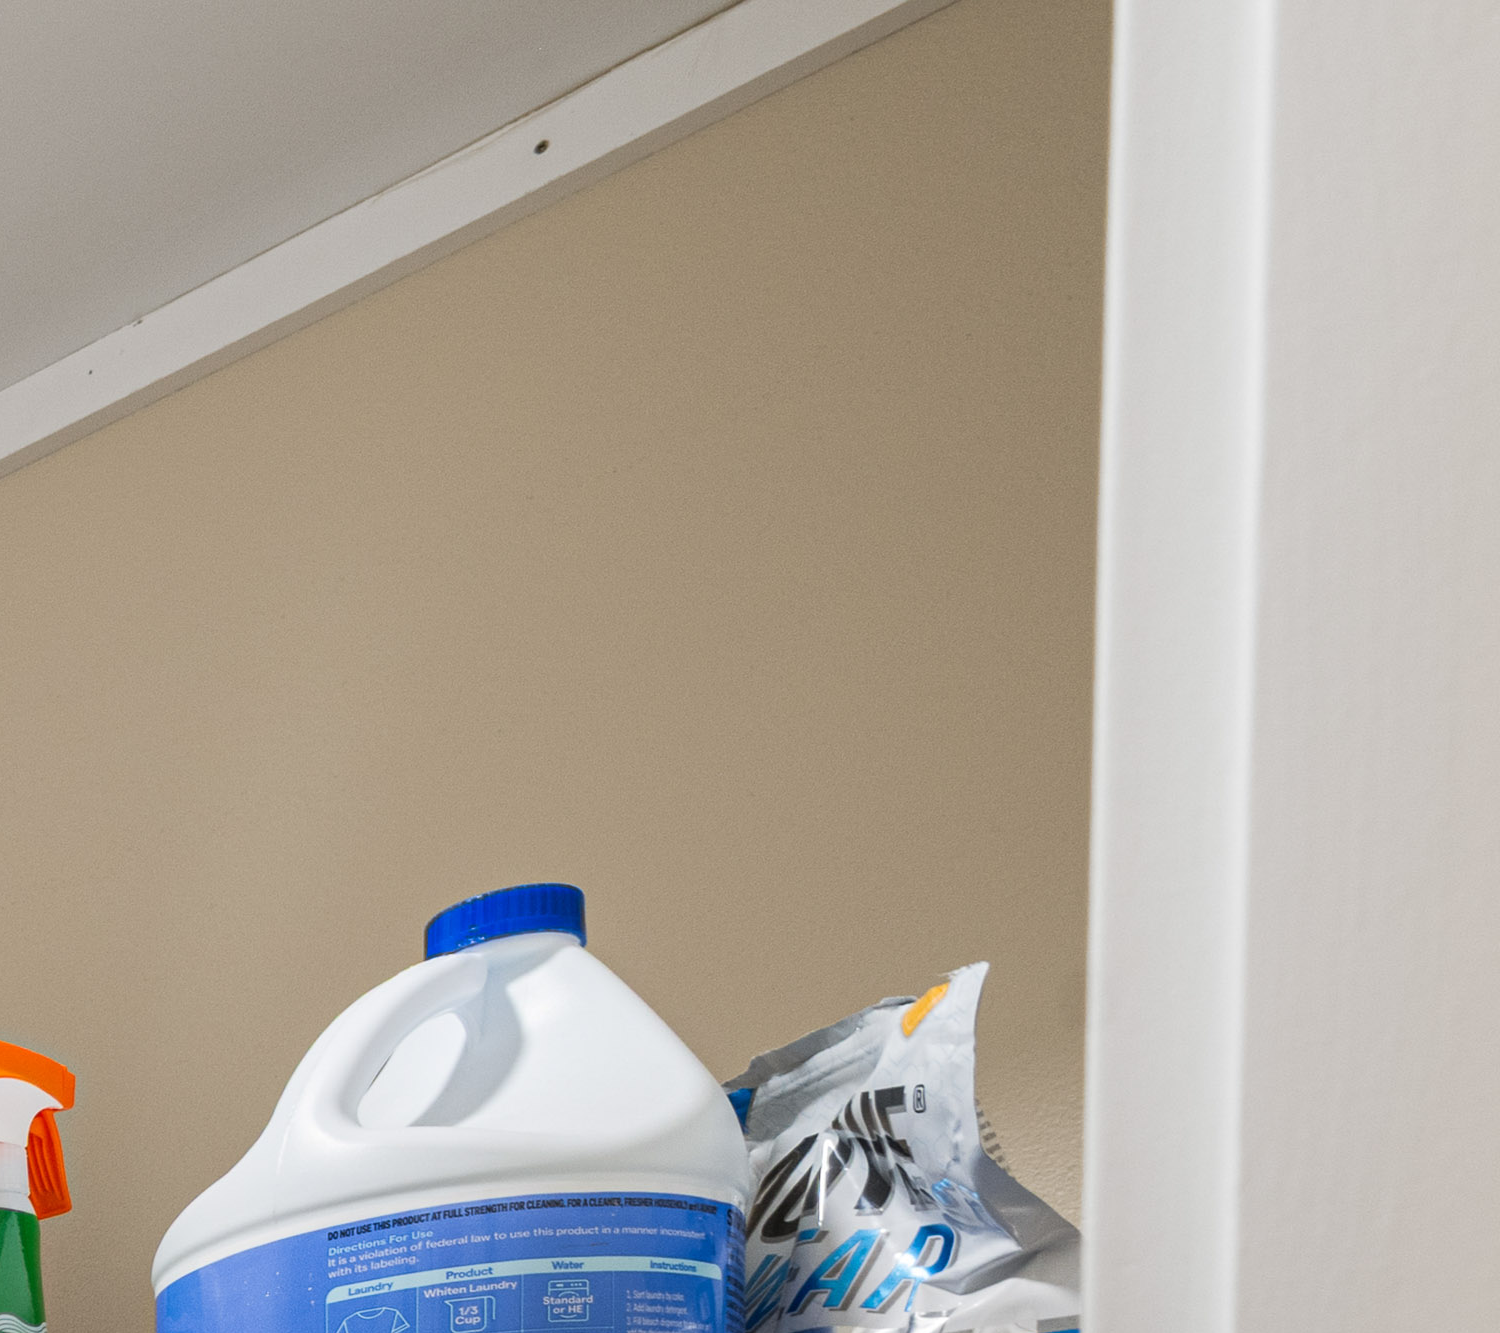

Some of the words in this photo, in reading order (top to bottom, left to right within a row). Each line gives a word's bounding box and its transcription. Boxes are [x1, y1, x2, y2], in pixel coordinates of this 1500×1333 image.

[328, 1231, 338, 1240] DO
[340, 1228, 355, 1238] NOT
[356, 1224, 371, 1235] USE
[373, 1221, 390, 1231] THIS
[392, 1213, 430, 1227] PRODUCT
[432, 1211, 441, 1221] AT
[443, 1208, 463, 1219] FULL
[465, 1203, 507, 1217] STRENGTH
[328, 1238, 386, 1256] Directions
[389, 1234, 407, 1244] For
[412, 1230, 434, 1240] Use
[359, 1245, 407, 1261] violation
[426, 1234, 468, 1249] federal
[471, 1233, 490, 1243] law
[494, 1231, 507, 1240] to
[510, 1230, 530, 1239] use
[533, 1227, 554, 1237] this
[556, 1226, 599, 1237] product
[328, 1267, 351, 1279] with
[371, 1254, 419, 1270] labeling.
[552, 1260, 584, 1270] Water
[650, 1260, 697, 1272] Instructions
[446, 1267, 493, 1279] Product
[348, 1281, 393, 1296] Laundry
[424, 1285, 467, 1298] Whiten
[469, 1281, 517, 1293] Laundry
[543, 1295, 593, 1305] Standard
[458, 1306, 478, 1315] 1/3
[568, 1305, 583, 1313] HE
[455, 1315, 481, 1325] Cup
